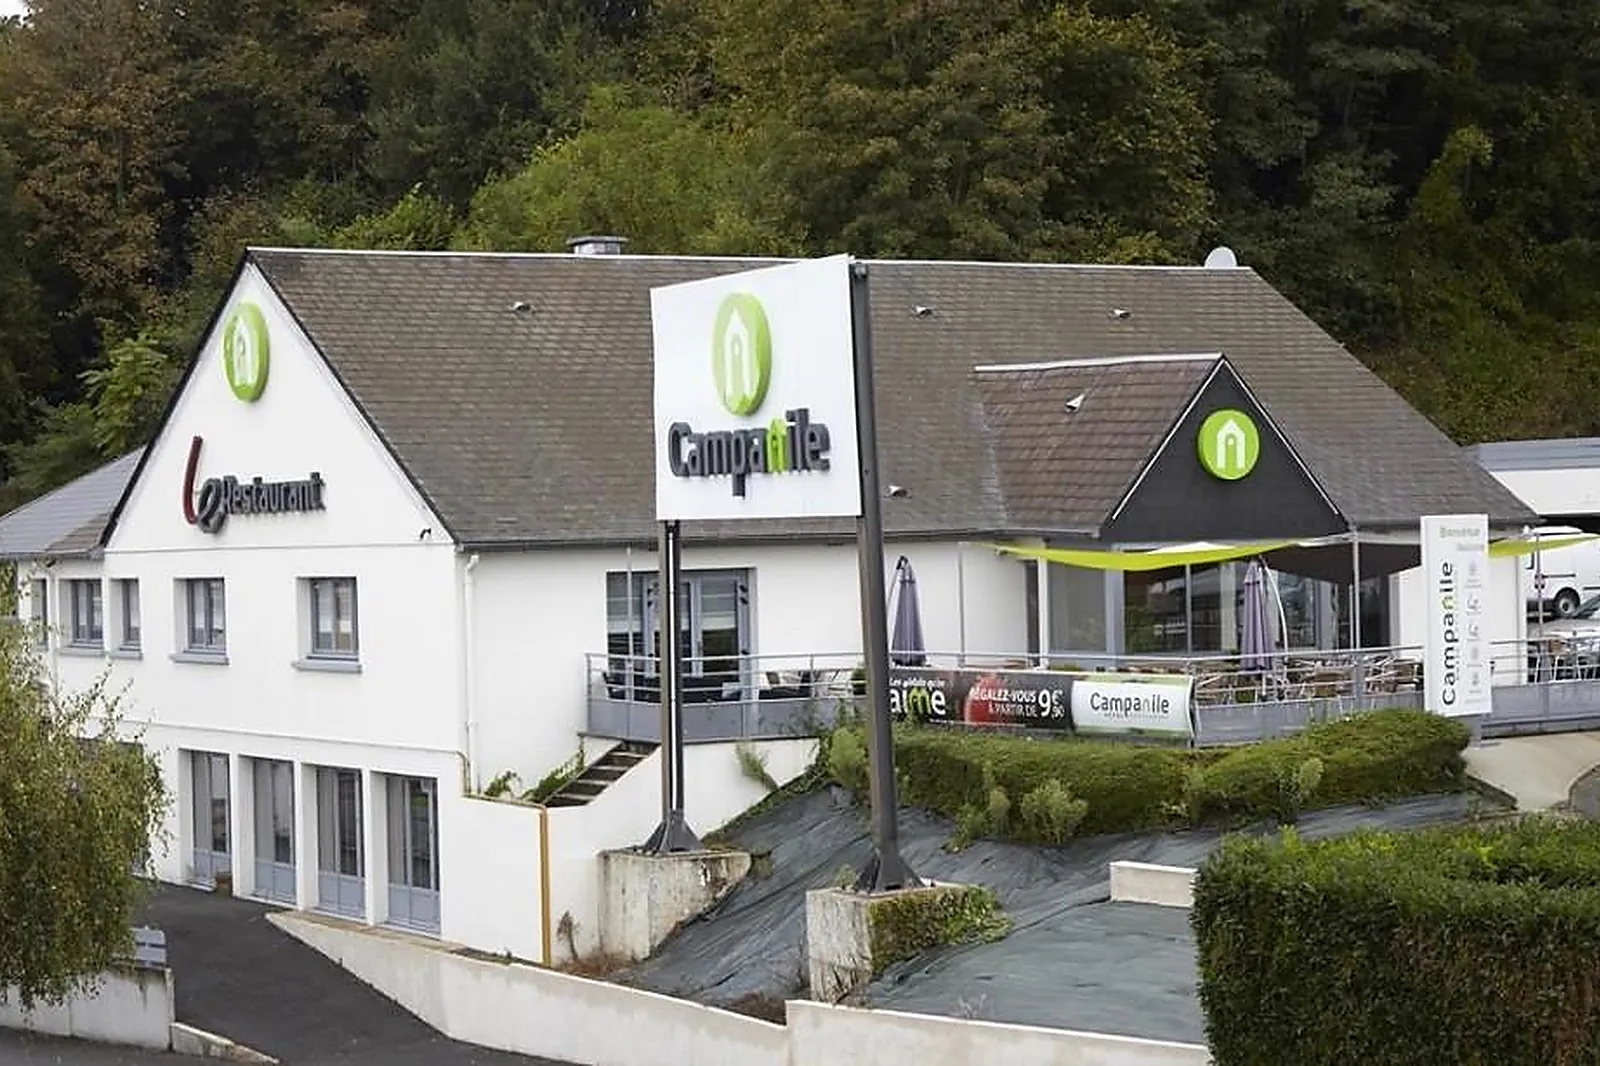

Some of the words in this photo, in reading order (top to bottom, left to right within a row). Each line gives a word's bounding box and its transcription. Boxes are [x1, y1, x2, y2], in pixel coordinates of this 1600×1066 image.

[668, 407, 831, 497] Campanile
[223, 472, 326, 516] Restaurant
[1440, 561, 1459, 706] Campanile
[890, 687, 946, 716] aime
[1090, 692, 1170, 717] Campanile
